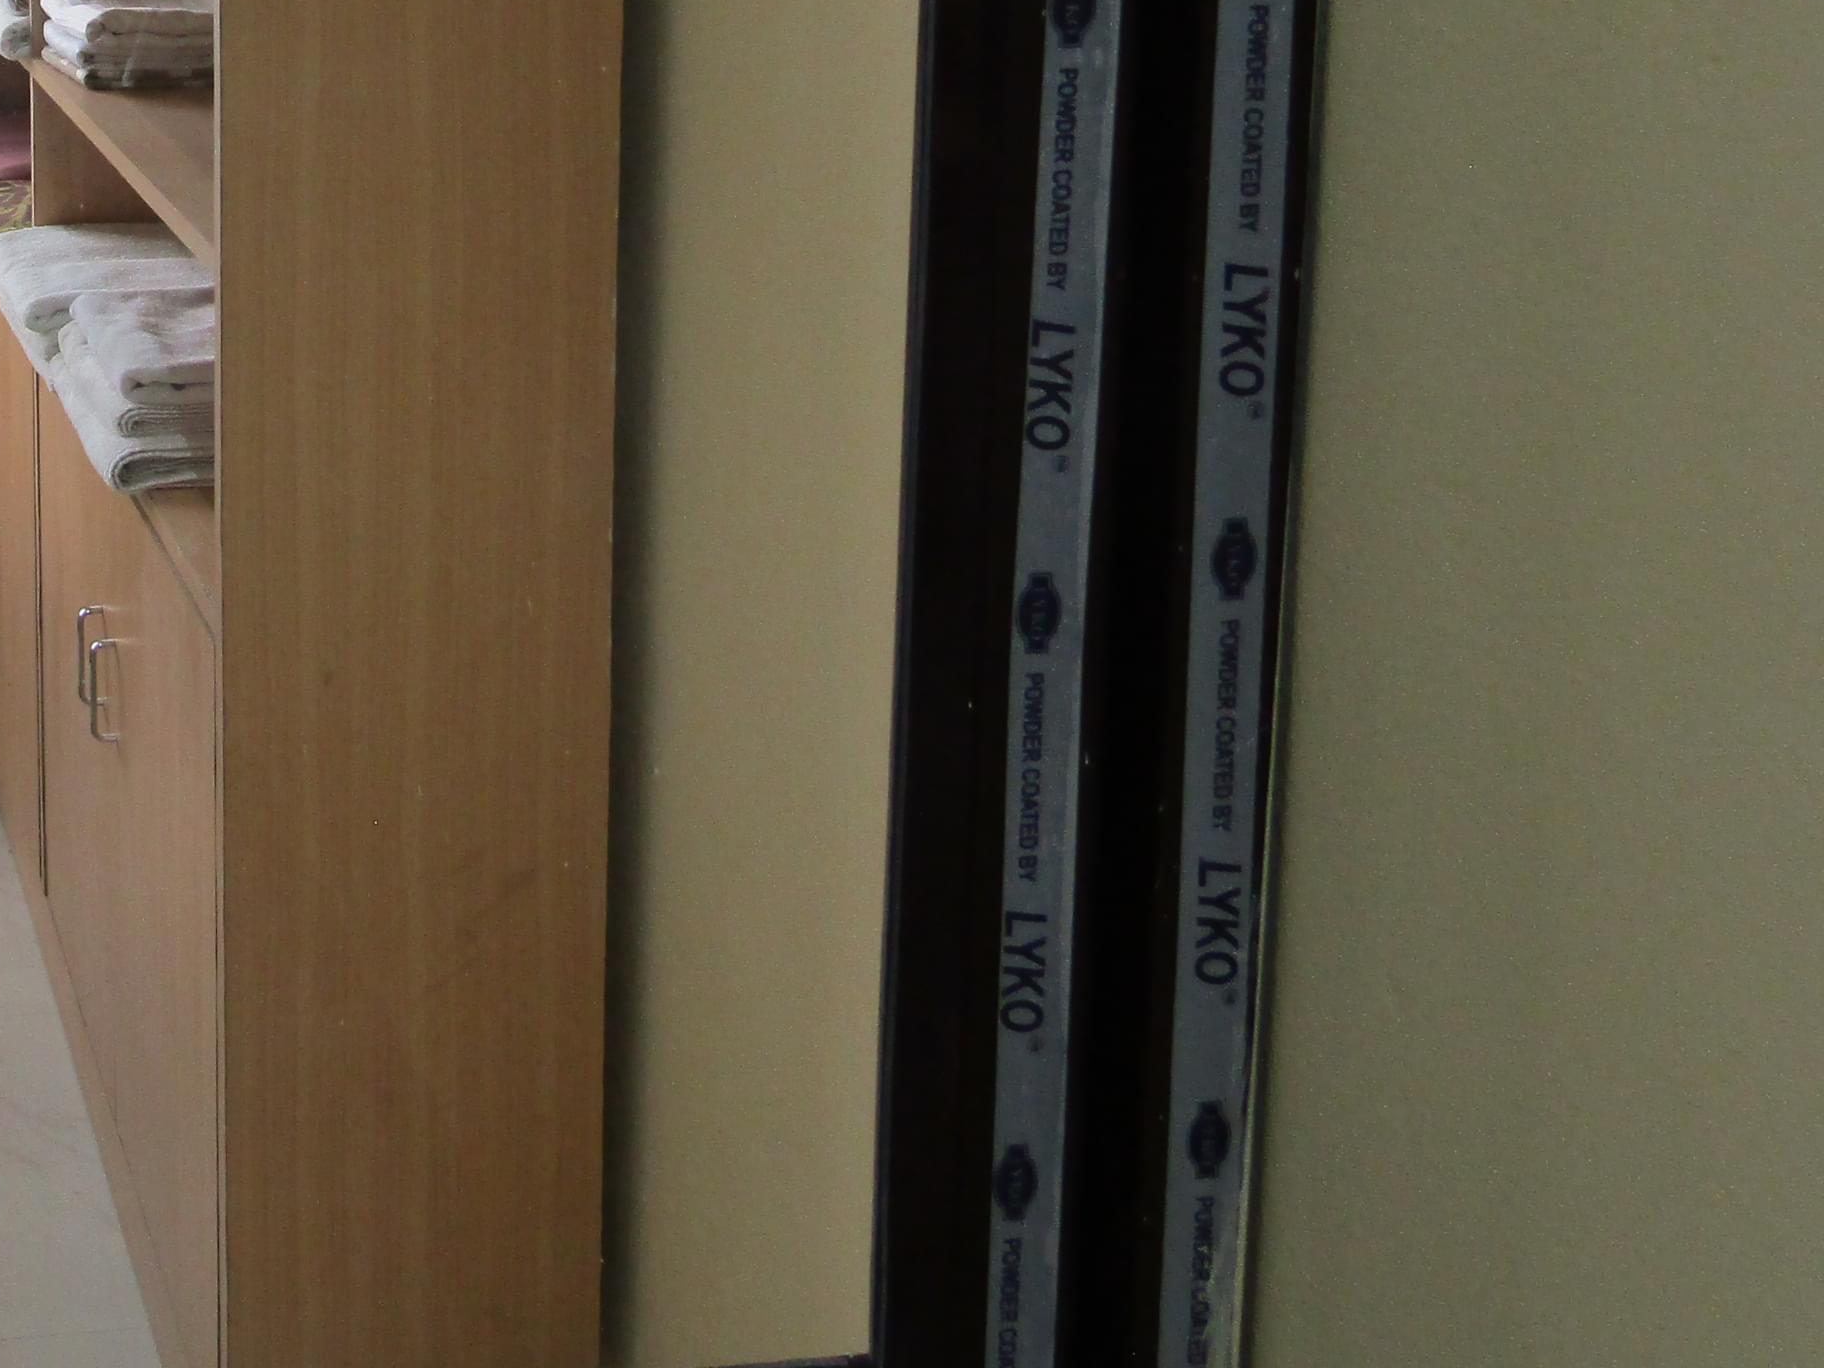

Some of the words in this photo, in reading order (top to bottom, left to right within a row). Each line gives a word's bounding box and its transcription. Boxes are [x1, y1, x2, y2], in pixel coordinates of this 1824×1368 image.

[1245, 4, 1270, 102] POWDER
[1054, 67, 1080, 163] POWDER
[1240, 106, 1265, 199] COATED
[1048, 168, 1074, 257] COATED
[1239, 202, 1261, 233] BY
[1046, 261, 1068, 291] BY
[1218, 263, 1269, 398] LYKO
[1024, 318, 1076, 452] LYKO
[1217, 618, 1241, 710] POWDER
[1022, 672, 1045, 763] POWDER
[1213, 715, 1238, 801] COATED
[1018, 767, 1042, 851] COATED
[1212, 803, 1233, 832] BY
[1017, 854, 1039, 883] BY
[1194, 859, 1242, 986] LYKO
[998, 910, 1047, 1034] LYKO
